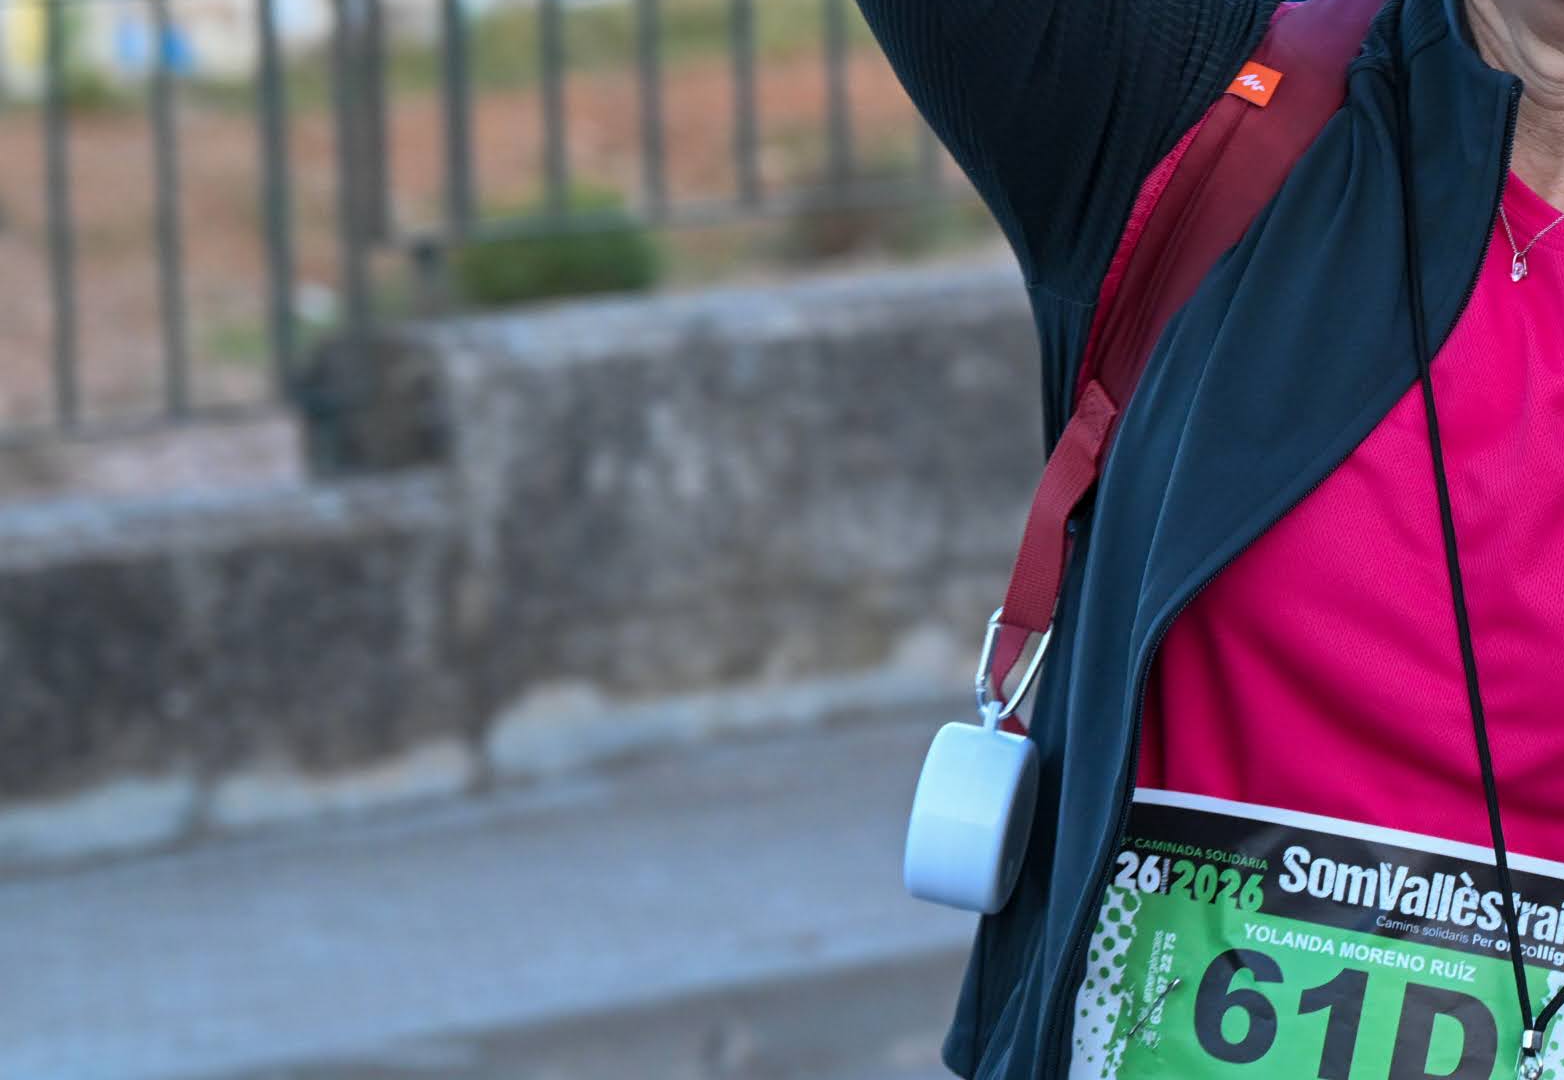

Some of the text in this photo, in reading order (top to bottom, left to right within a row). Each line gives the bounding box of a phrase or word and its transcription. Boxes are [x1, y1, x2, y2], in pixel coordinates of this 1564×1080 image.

[1134, 838, 1202, 857] CAMINADA
[1114, 850, 1162, 894] 26
[1169, 859, 1264, 913] 2026
[1376, 915, 1420, 934] Camins
[1422, 924, 1468, 945] solidaris
[1243, 923, 1477, 983] YOLANDA MORENO RUÍZ
